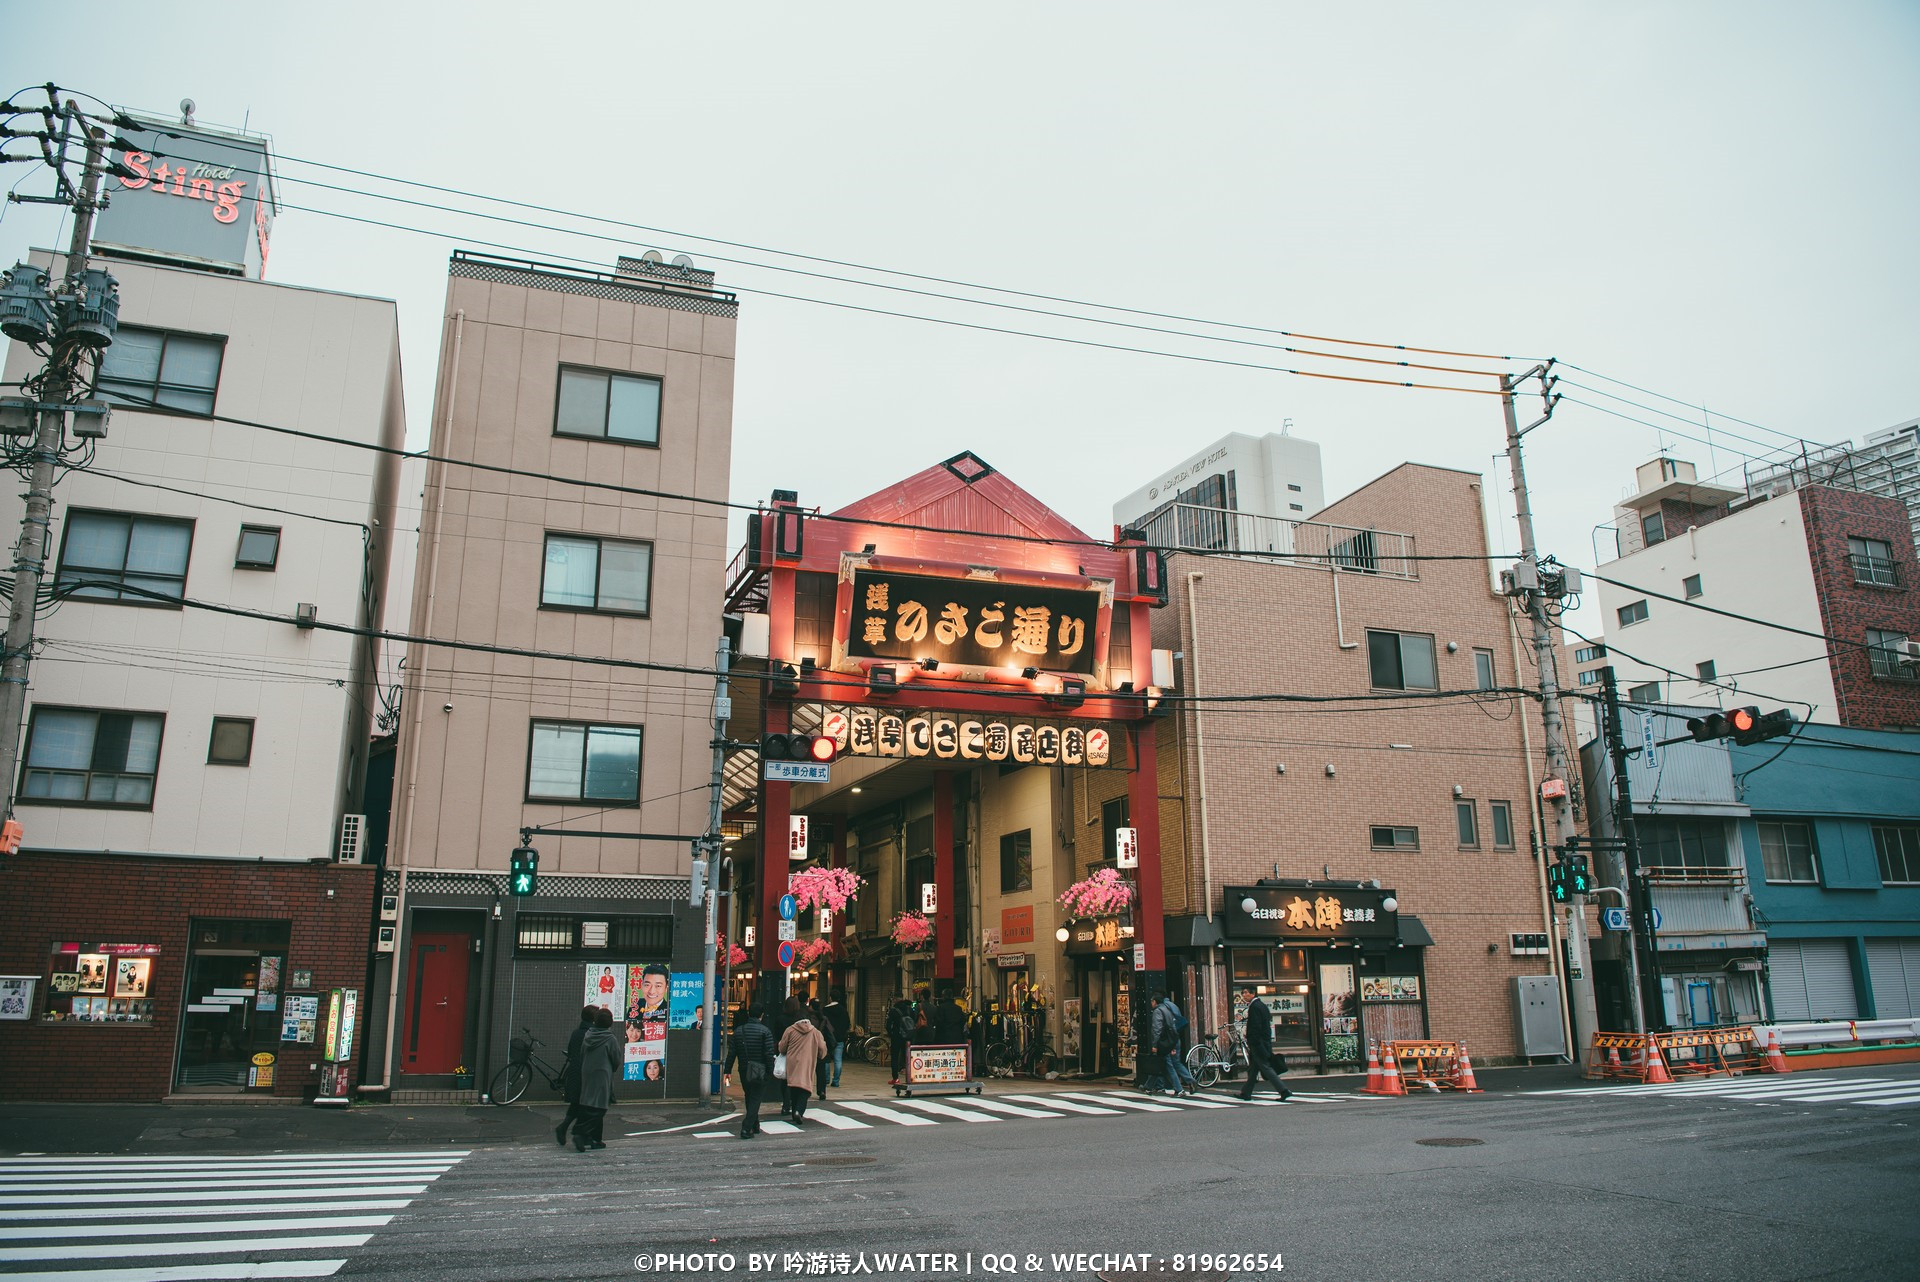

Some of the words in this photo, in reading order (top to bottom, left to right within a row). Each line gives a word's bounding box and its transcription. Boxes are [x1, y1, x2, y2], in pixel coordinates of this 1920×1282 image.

[119, 151, 247, 224] Sting
[191, 162, 237, 180] Hotel
[1163, 471, 1189, 491] ASAKUSA
[1190, 458, 1206, 474] VIEW
[1208, 447, 1228, 464] HOTEL
[862, 582, 889, 646] 浅草
[894, 600, 1086, 655] ひさご通り
[1286, 896, 1343, 931] 本陣
[1342, 908, 1376, 922] 生蕎麦
[628, 966, 644, 1019] 木村たけつか
[642, 1024, 665, 1036] 七海
[627, 1063, 639, 1075] 釈
[924, 1058, 965, 1068] 車両通行止
